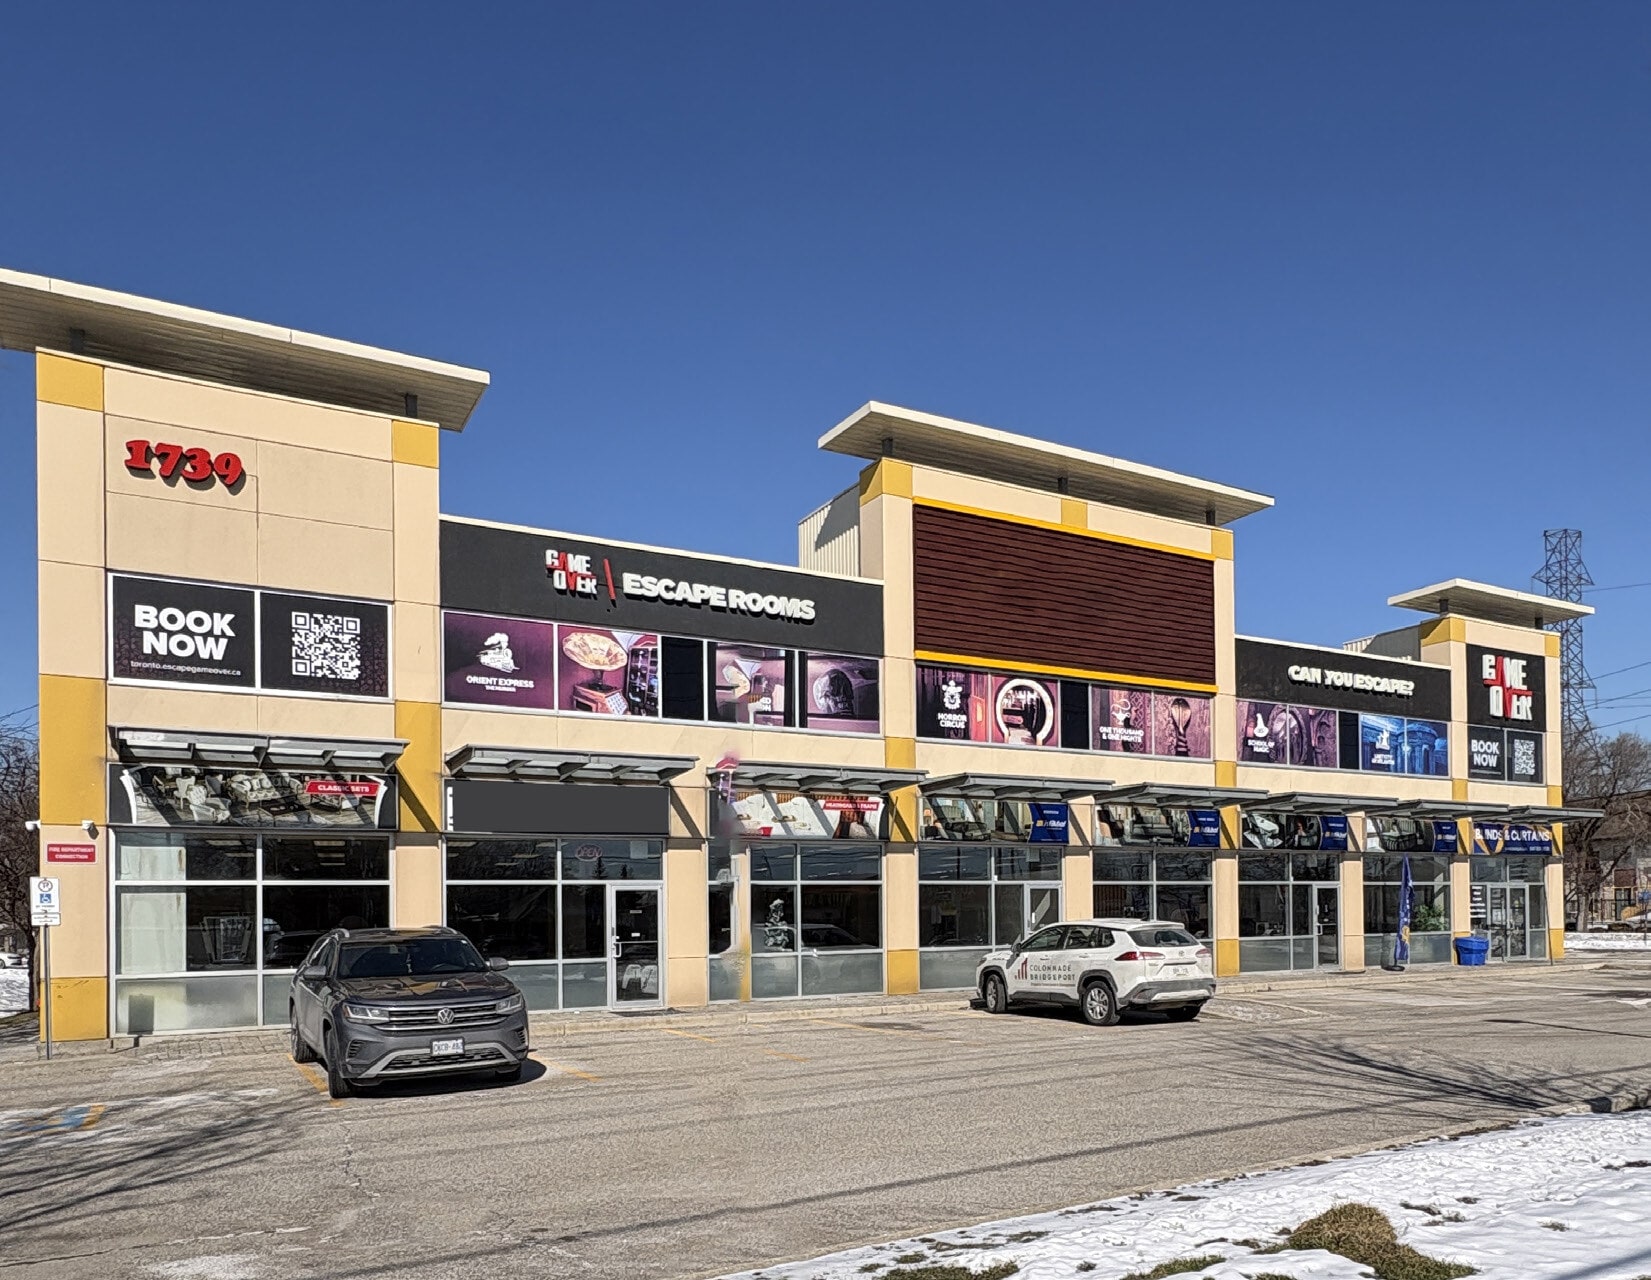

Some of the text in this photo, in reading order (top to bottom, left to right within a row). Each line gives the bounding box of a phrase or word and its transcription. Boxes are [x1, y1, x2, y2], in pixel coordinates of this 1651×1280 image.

[125, 440, 243, 486] 1739
[545, 549, 593, 575] GAME
[553, 570, 598, 594] OVER
[622, 573, 816, 620] ESCAPE ROOMS
[134, 604, 236, 637] BOOK
[142, 631, 228, 660] NOW
[130, 660, 241, 676] toronto.escapegameover.ca
[466, 675, 534, 688] ORIENT EXPRESS
[1288, 665, 1415, 696] CAN YOU ESCAPE?
[937, 712, 967, 722] HORROR
[940, 720, 966, 729] CIRCUS
[1099, 726, 1144, 737] ONE THOUSAND
[1471, 739, 1500, 754] BOOK
[1473, 755, 1498, 767] NOW
[317, 784, 370, 793] CLASSIC SETS
[1030, 973, 1076, 981] BRIDGEPORT
